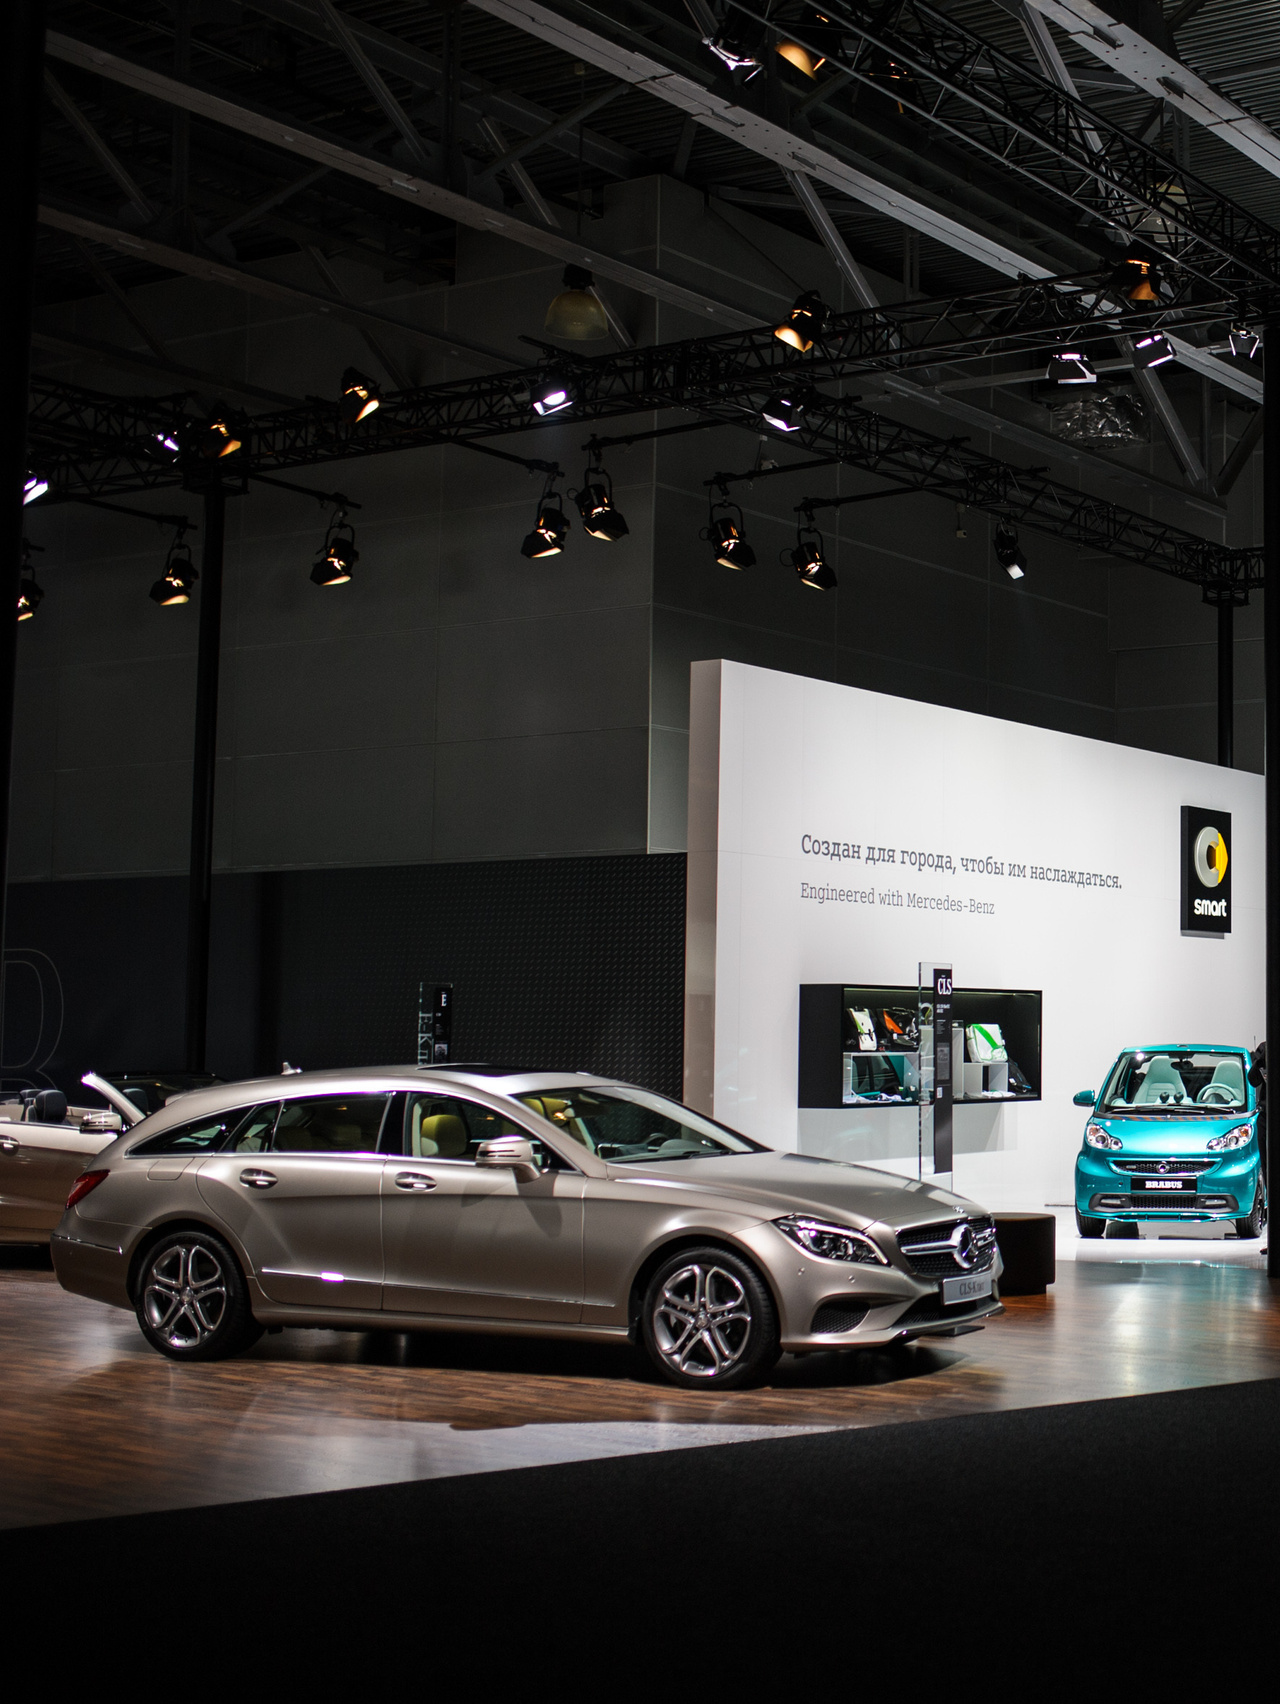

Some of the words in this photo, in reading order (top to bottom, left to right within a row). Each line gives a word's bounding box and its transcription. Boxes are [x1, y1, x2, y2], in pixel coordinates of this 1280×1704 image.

[801, 834, 861, 861] Создан
[866, 845, 896, 865] для
[900, 850, 957, 875] города,
[960, 856, 1005, 876] чтобы
[1008, 863, 1027, 878] им
[1030, 865, 1123, 889] наслаждаться.
[800, 882, 875, 904] Engineered
[879, 889, 904, 907] with
[907, 892, 995, 915] Mercedes-Benz
[1193, 898, 1227, 917] smart
[937, 978, 952, 995] CLS
[1145, 1180, 1183, 1189] BRABUS
